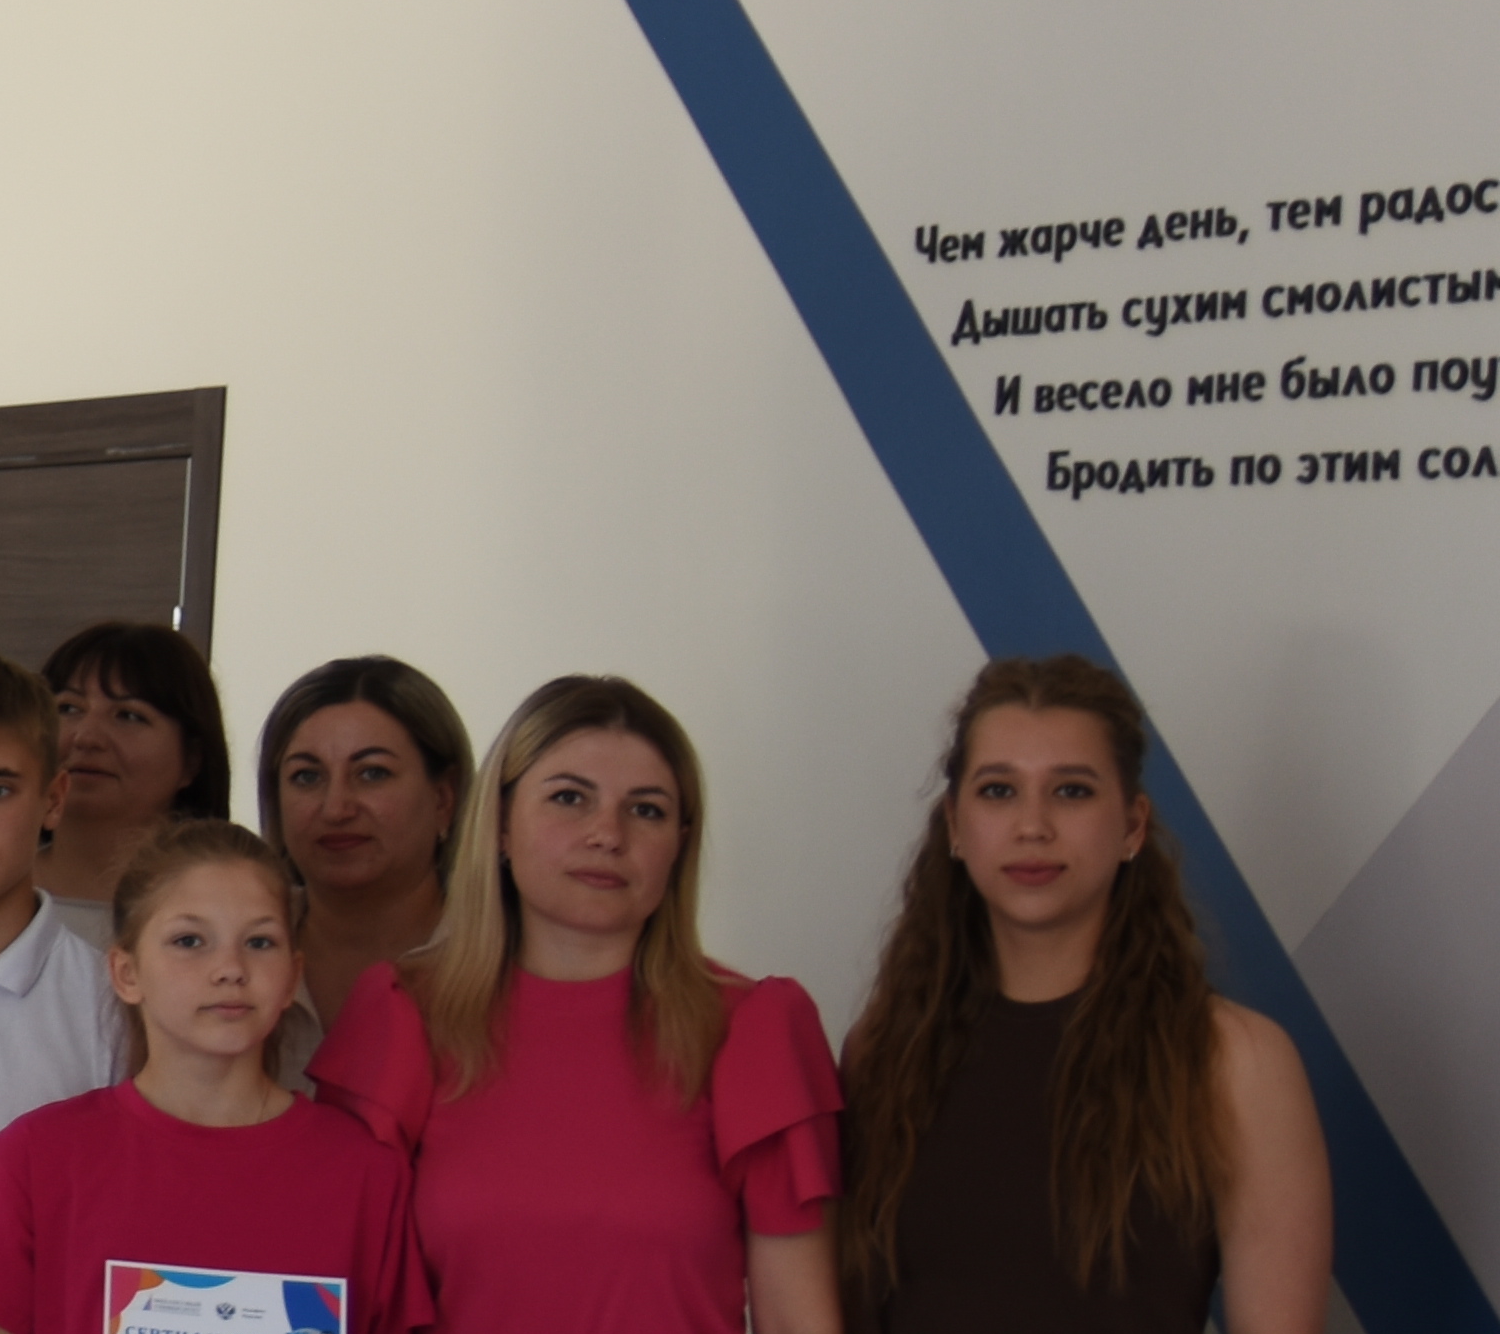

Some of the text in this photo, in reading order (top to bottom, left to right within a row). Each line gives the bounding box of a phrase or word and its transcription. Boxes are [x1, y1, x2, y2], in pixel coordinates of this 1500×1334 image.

[915, 178, 1500, 263] Чем жарче день, тем радос
[952, 299, 1108, 346] Дышать
[1122, 289, 1247, 337] сухим
[994, 374, 1022, 415] И
[1034, 378, 1173, 413] весело
[1186, 370, 1266, 406] мне
[1281, 355, 1396, 400] было
[1047, 450, 1215, 500] Бродить
[1230, 453, 1282, 485] по
[1296, 449, 1401, 485] этим
